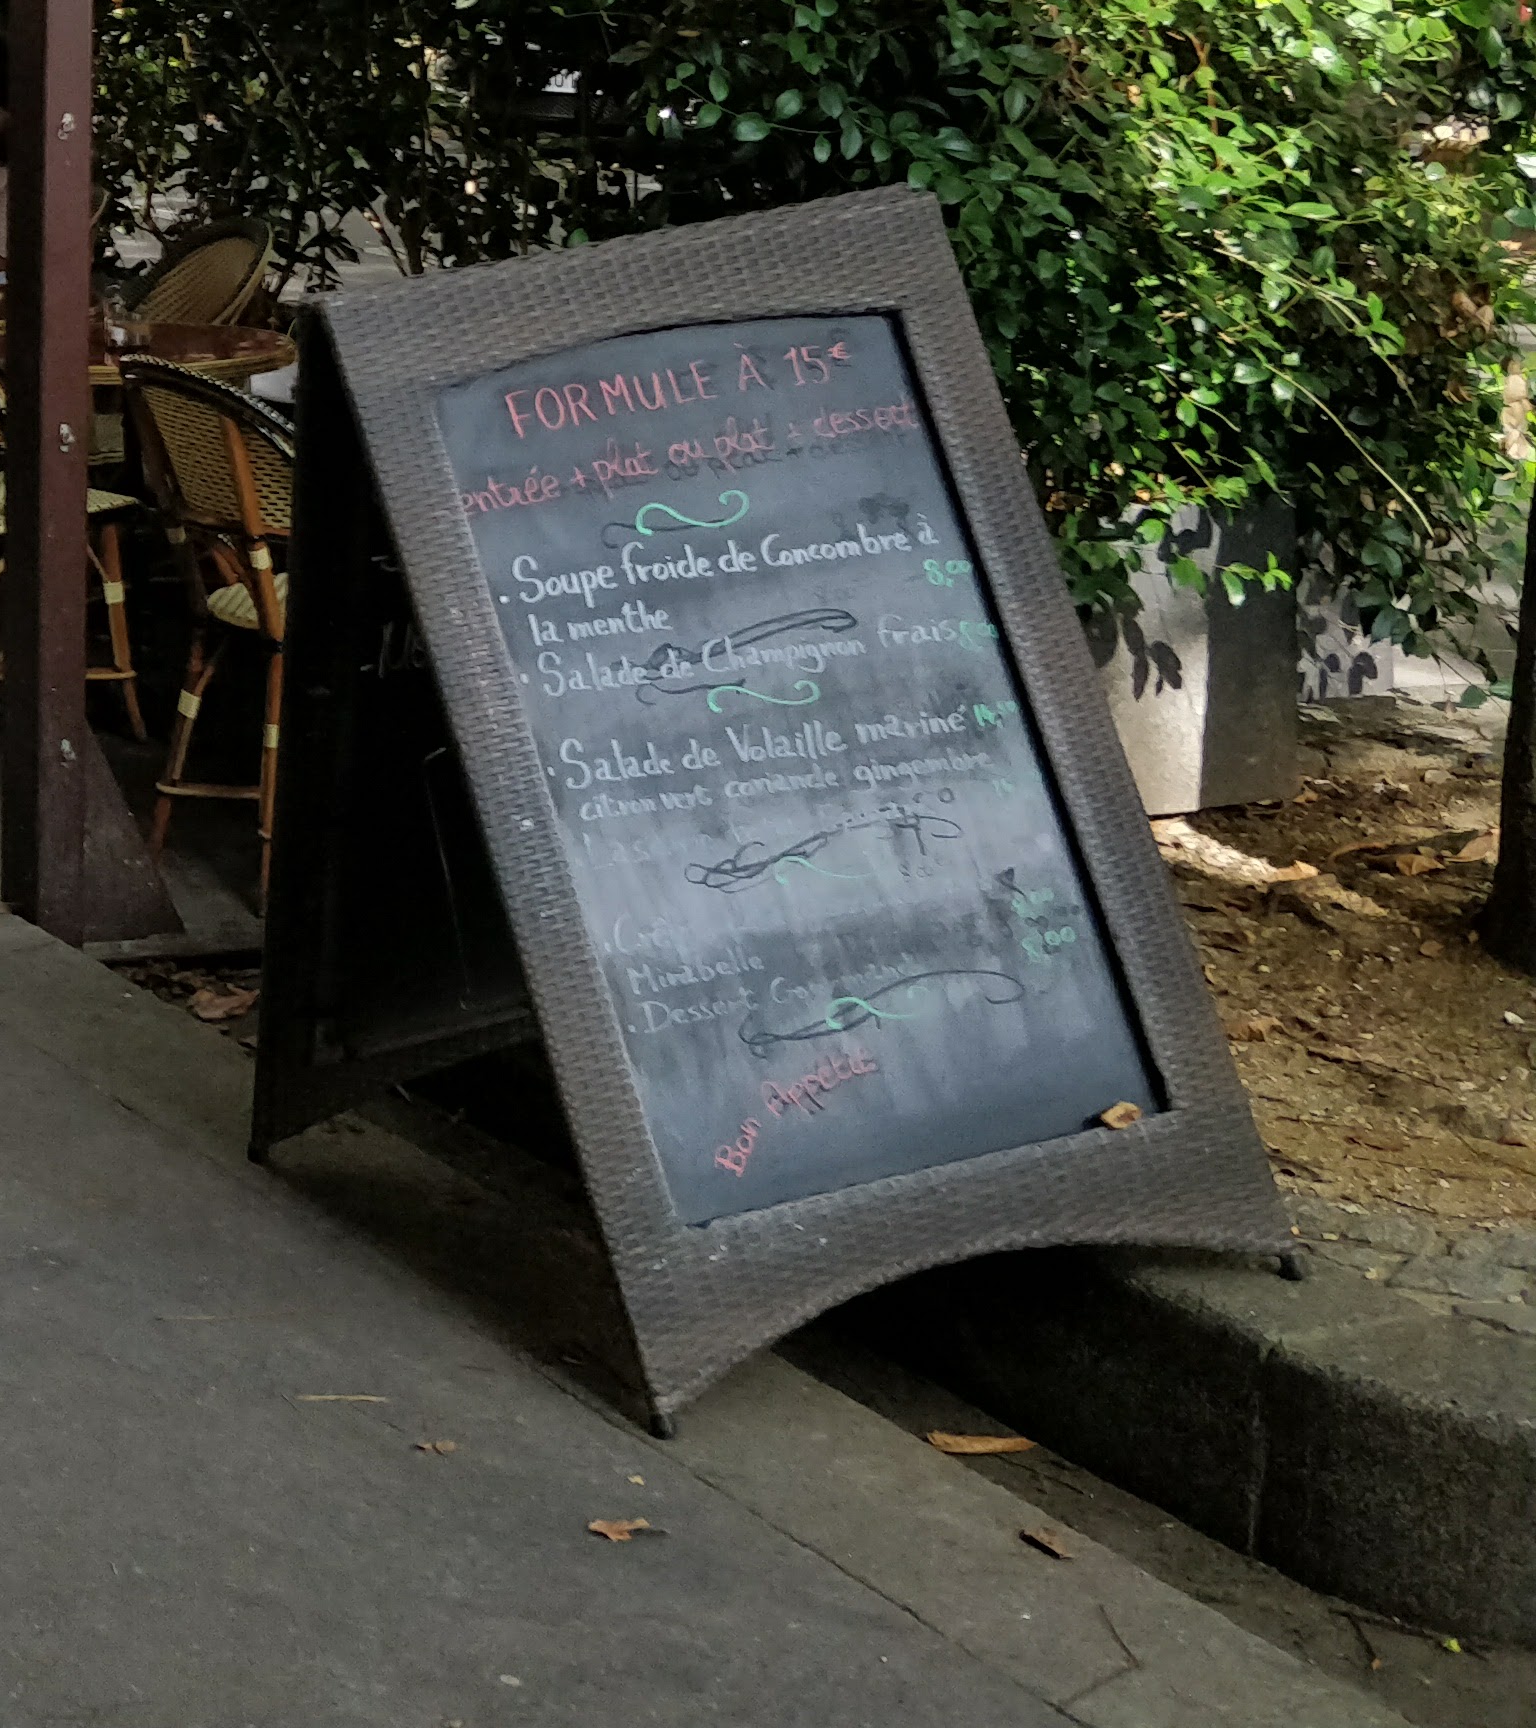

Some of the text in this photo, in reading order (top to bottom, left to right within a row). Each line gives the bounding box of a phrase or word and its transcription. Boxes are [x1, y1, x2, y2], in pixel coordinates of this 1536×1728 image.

[504, 360, 721, 440] FORMULE
[460, 464, 561, 513] entrée
[591, 437, 659, 500] plat
[667, 438, 714, 465] ou
[713, 415, 775, 472] plat
[512, 512, 940, 609] Soupe froide de Concombre à
[527, 599, 674, 647] la menthe
[536, 614, 958, 698] Salade de Champignon frais
[560, 738, 676, 791] Salade
[680, 737, 722, 770] de
[724, 719, 849, 763] Volaille
[626, 943, 765, 996] Mirabelle
[714, 1116, 762, 1179] Bon
